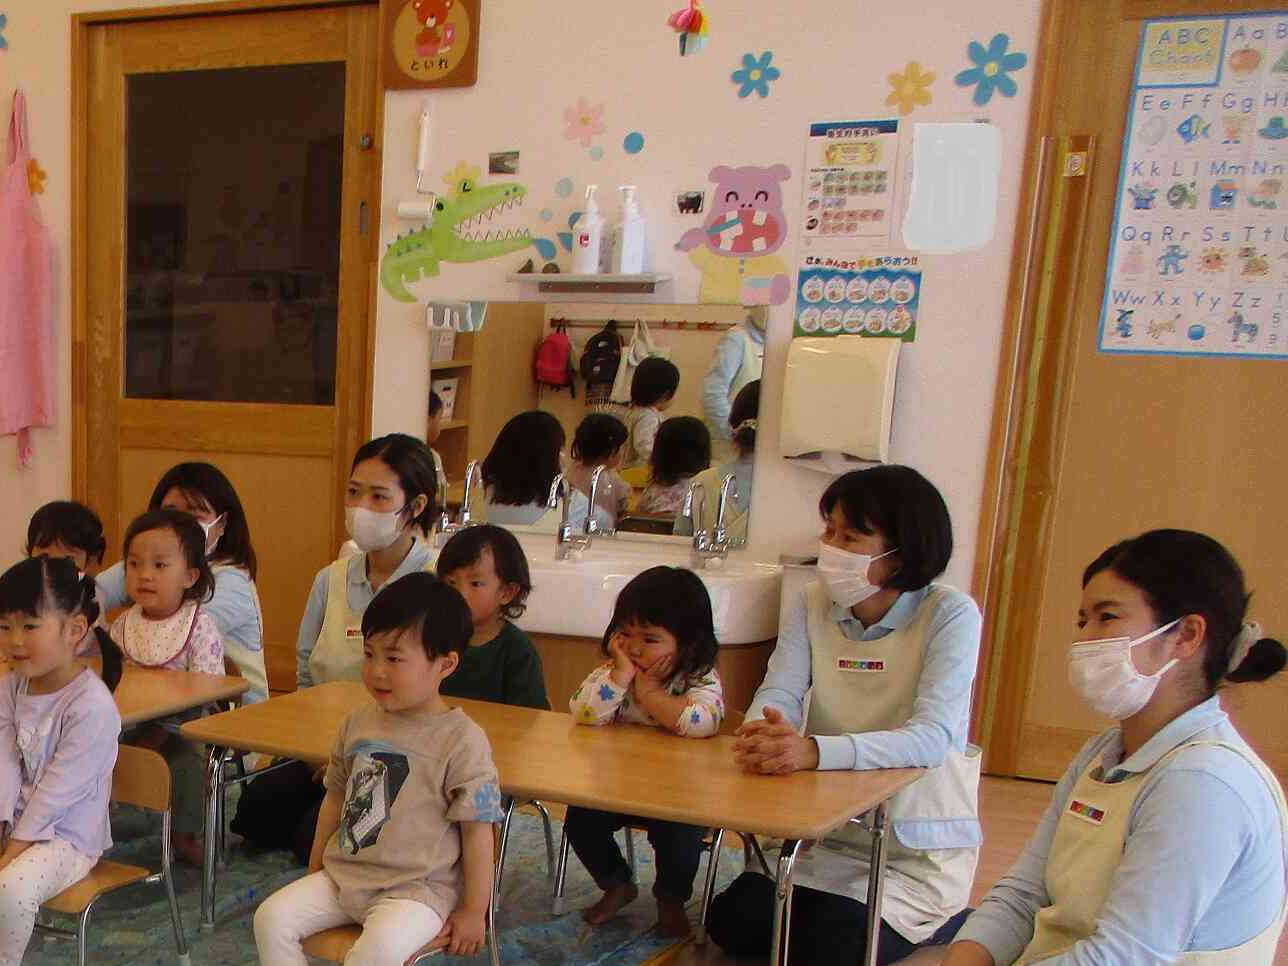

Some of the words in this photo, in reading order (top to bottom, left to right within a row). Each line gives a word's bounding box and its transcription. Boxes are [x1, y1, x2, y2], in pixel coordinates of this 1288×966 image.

[411, 56, 448, 71] といれ
[1149, 49, 1212, 65] Chart
